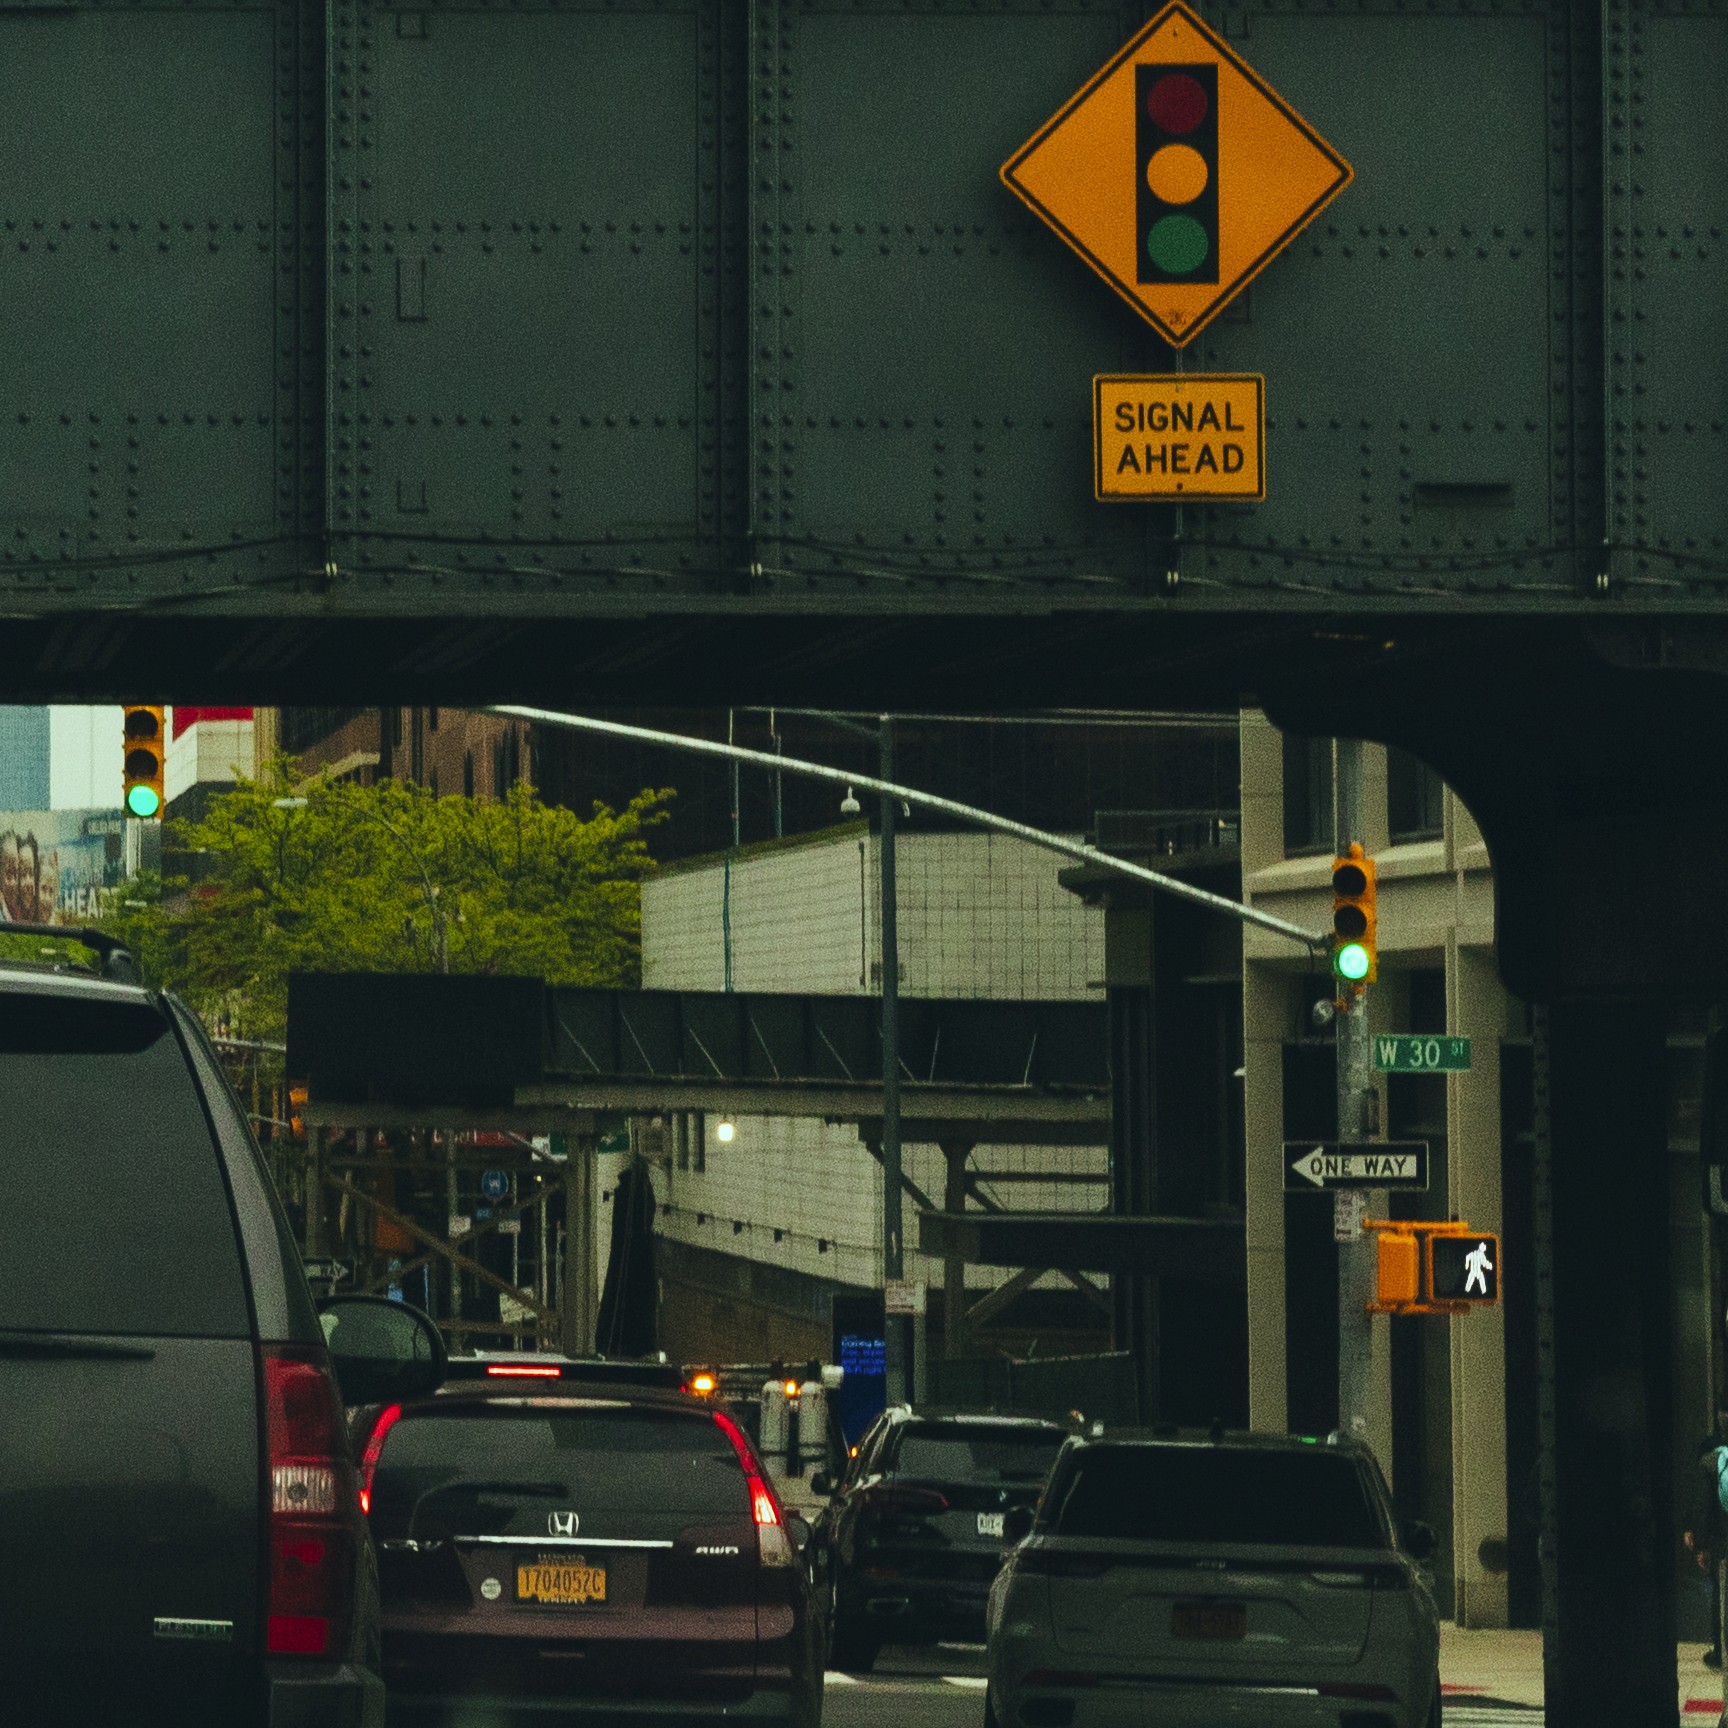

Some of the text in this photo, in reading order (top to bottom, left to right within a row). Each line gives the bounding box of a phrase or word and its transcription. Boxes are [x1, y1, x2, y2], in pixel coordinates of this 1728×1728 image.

[1115, 401, 1244, 432] SIGNAL
[1117, 443, 1244, 474] AHEAD
[1379, 1040, 1464, 1067] W 30 ST
[1310, 1158, 1406, 1176] ONE WAY
